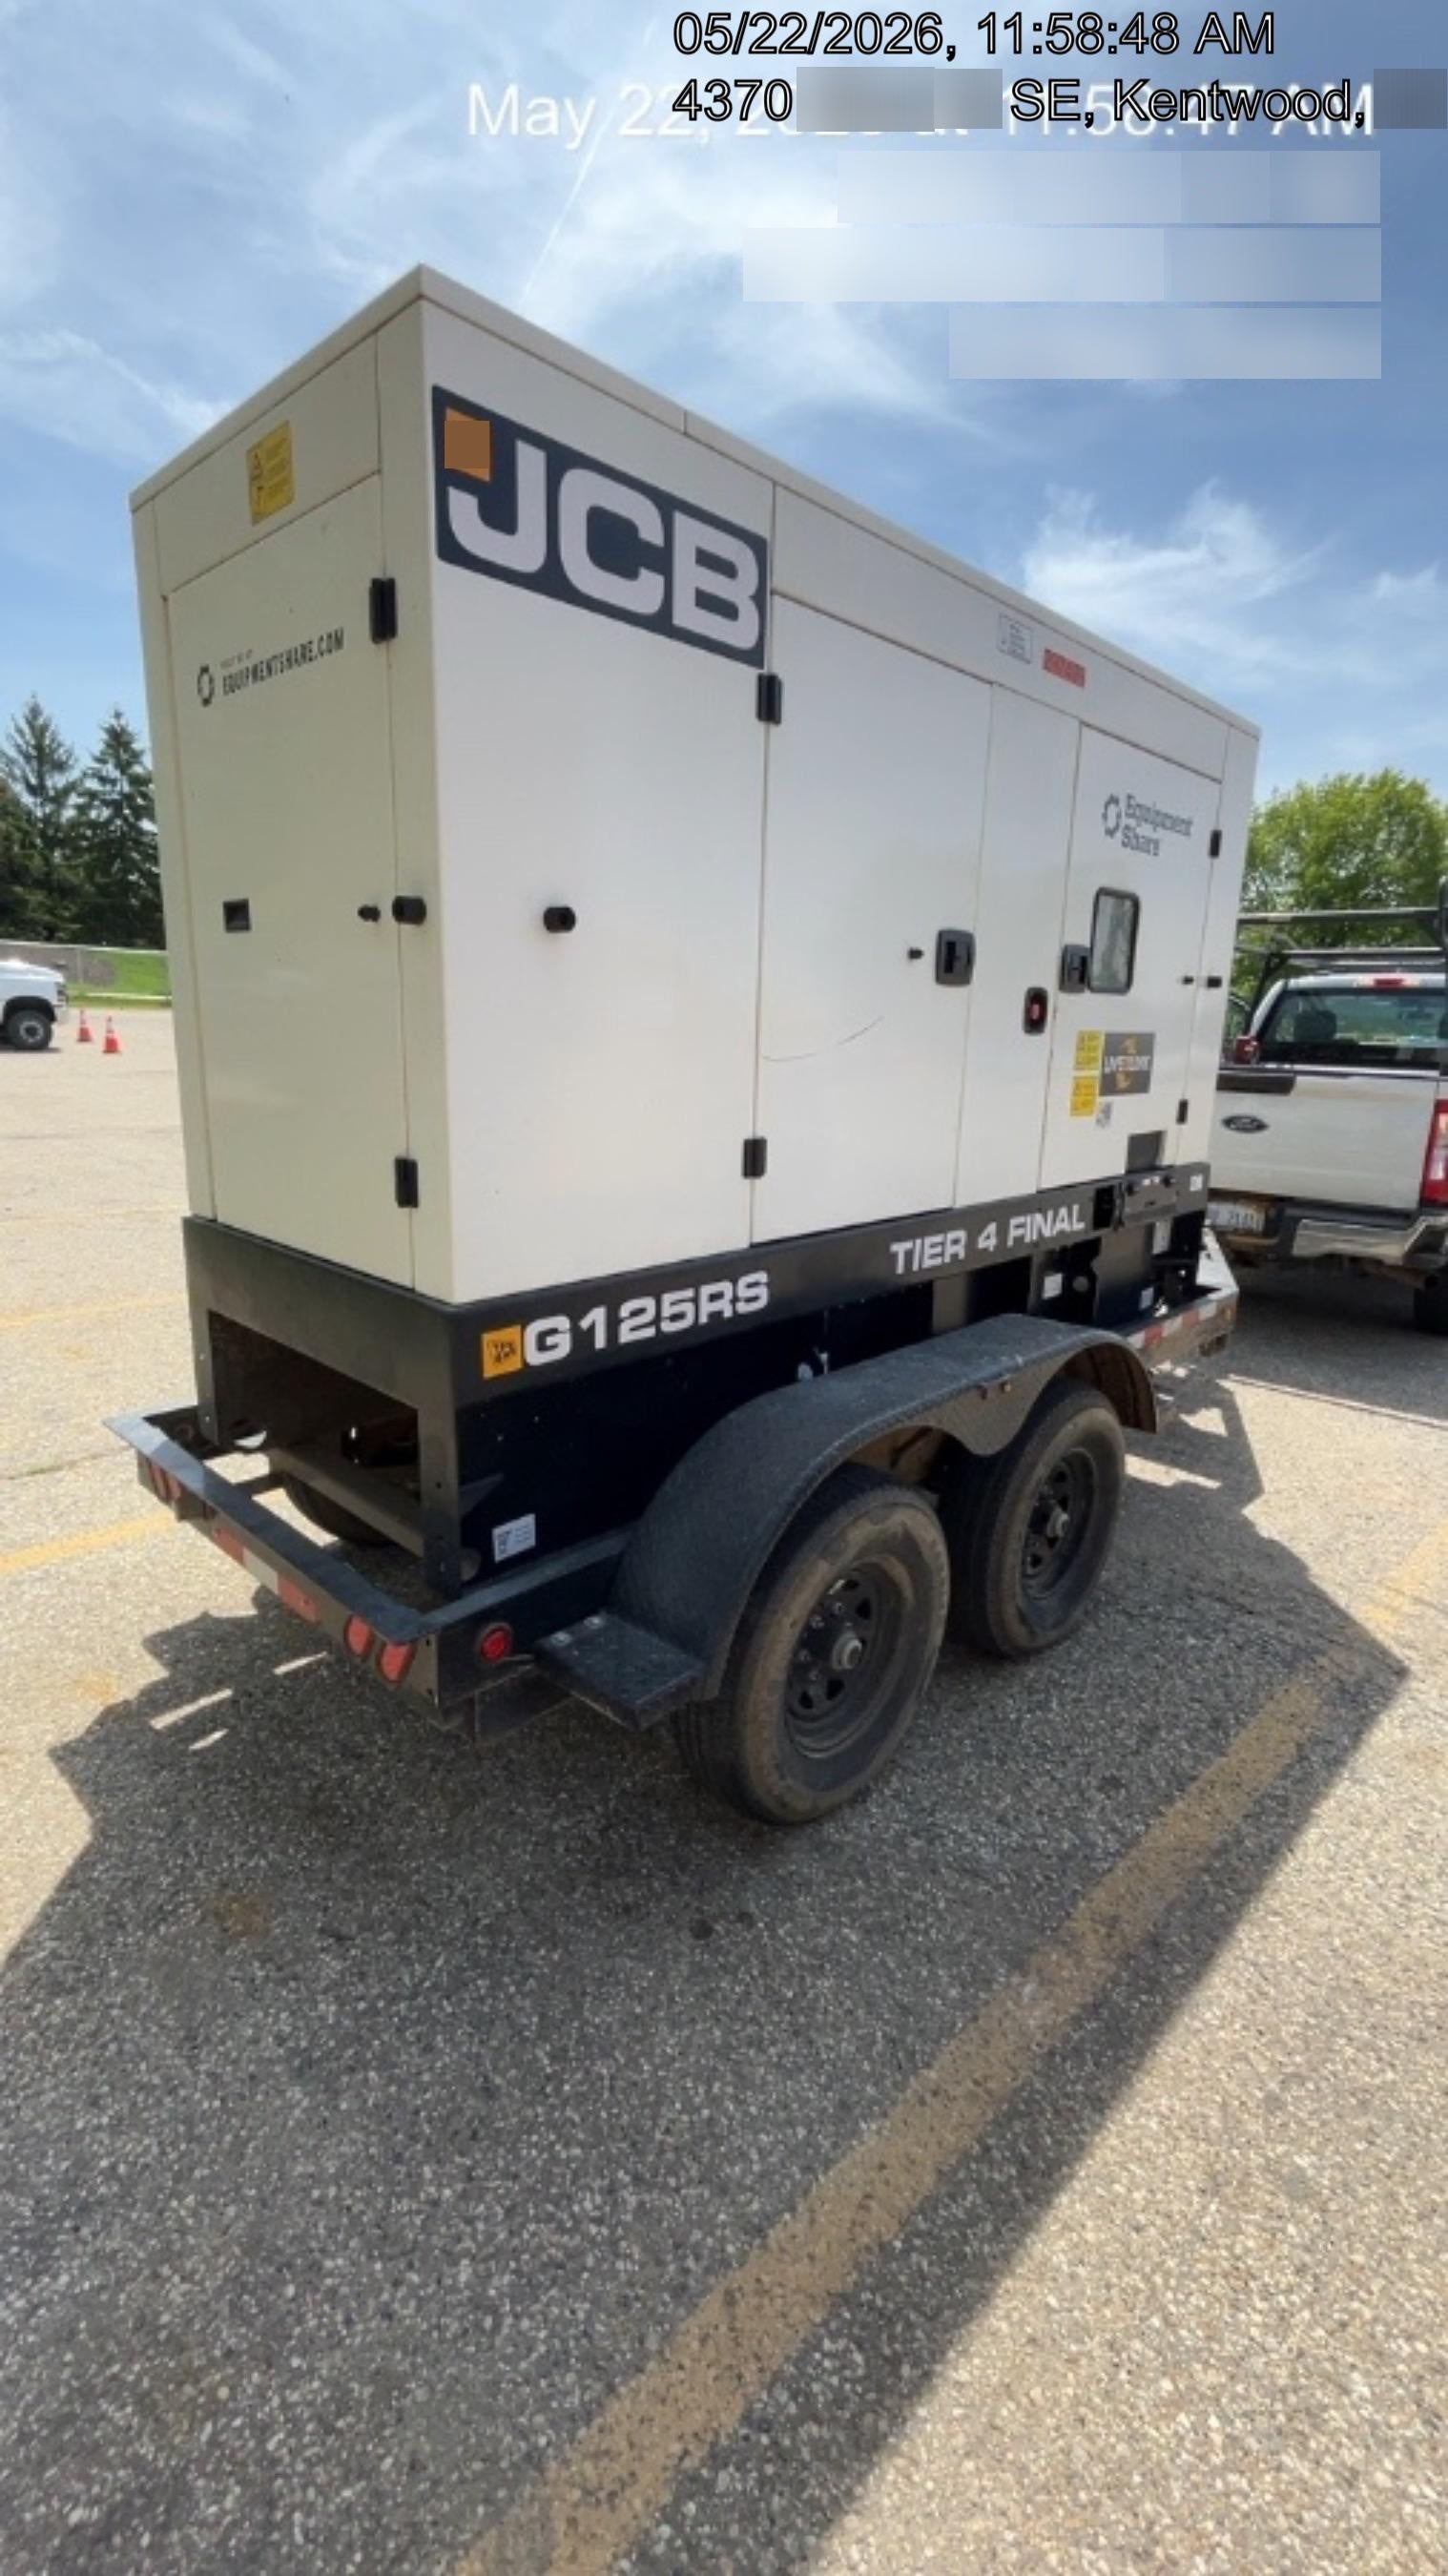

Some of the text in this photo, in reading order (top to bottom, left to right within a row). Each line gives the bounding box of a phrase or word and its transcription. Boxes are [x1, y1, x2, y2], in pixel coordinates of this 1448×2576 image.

[446, 438, 762, 653] JCB
[1122, 823, 1160, 856] Share
[1125, 793, 1193, 838] Equipment
[891, 1203, 1086, 1275] TIER 4 FINAL
[522, 1270, 771, 1366] G125RS
